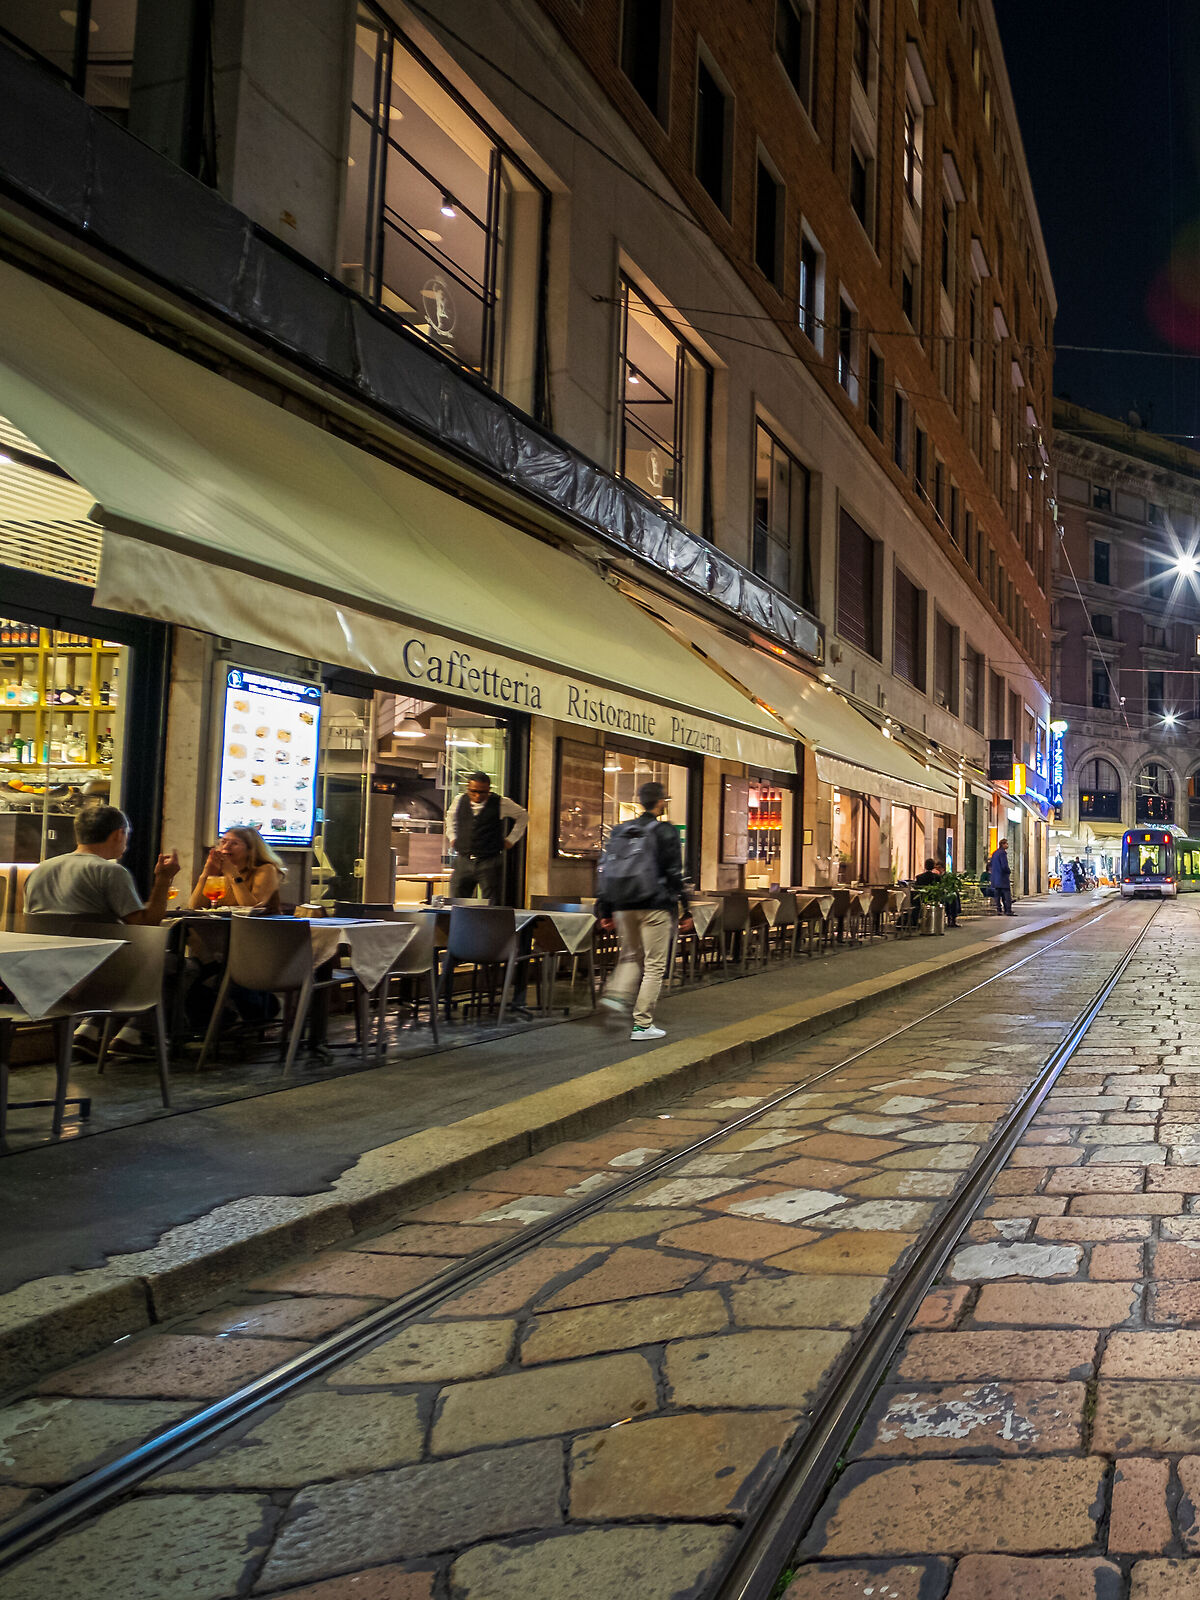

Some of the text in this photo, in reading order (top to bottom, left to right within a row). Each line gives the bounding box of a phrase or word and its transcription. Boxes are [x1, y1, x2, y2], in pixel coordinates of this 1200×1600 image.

[402, 639, 722, 753] Caffetteria Ristorante Pizzeria
[1053, 731, 1064, 803] PIZZERIA
